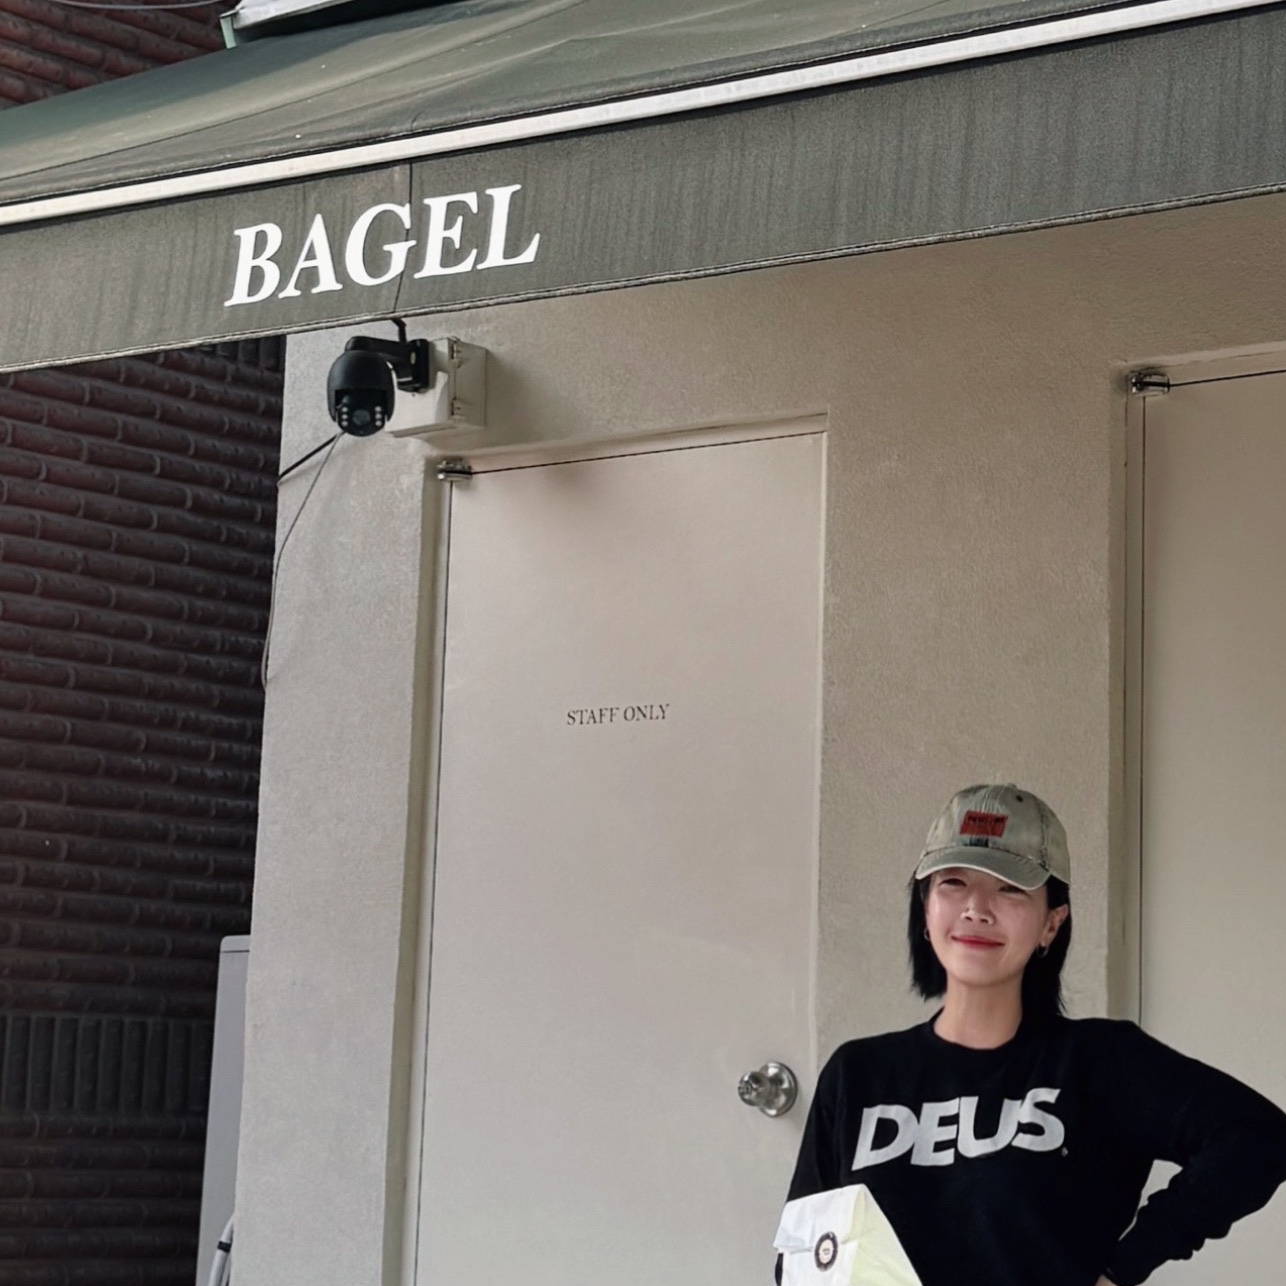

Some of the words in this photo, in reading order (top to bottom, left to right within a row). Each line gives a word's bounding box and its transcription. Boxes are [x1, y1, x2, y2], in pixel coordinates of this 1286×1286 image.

[224, 184, 541, 307] BAGEL
[567, 707, 620, 725] STAFF
[623, 704, 670, 721] ONLY
[851, 1087, 1065, 1171] DEUS
